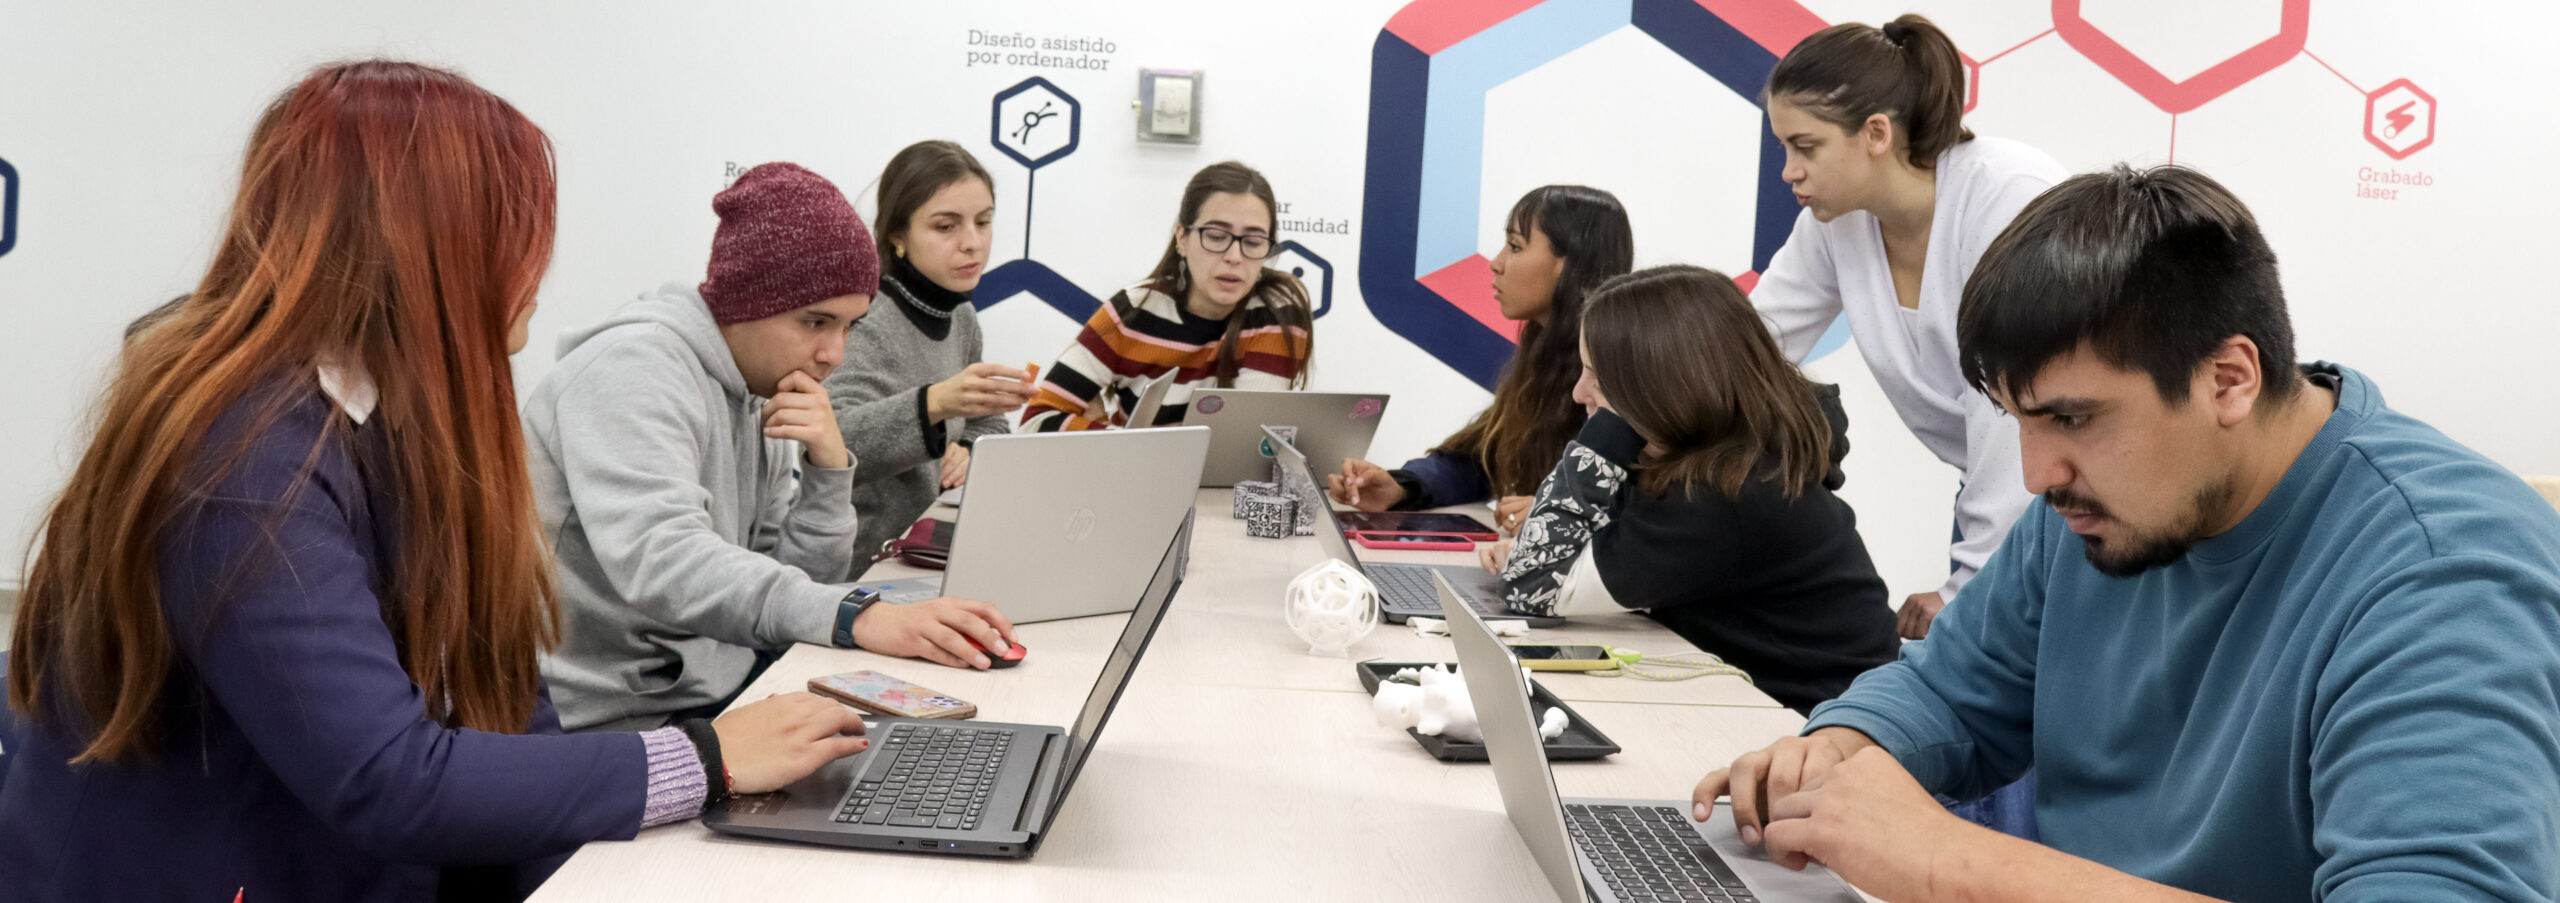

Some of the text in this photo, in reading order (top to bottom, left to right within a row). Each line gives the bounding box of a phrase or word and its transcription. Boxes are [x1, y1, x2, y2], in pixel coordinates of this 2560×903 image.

[968, 29, 1117, 54] Diseño asistido
[967, 50, 1110, 71] por ordenador
[2358, 166, 2434, 186] Grabado
[2356, 182, 2399, 200] láser
[1276, 217, 1350, 235] unidad
